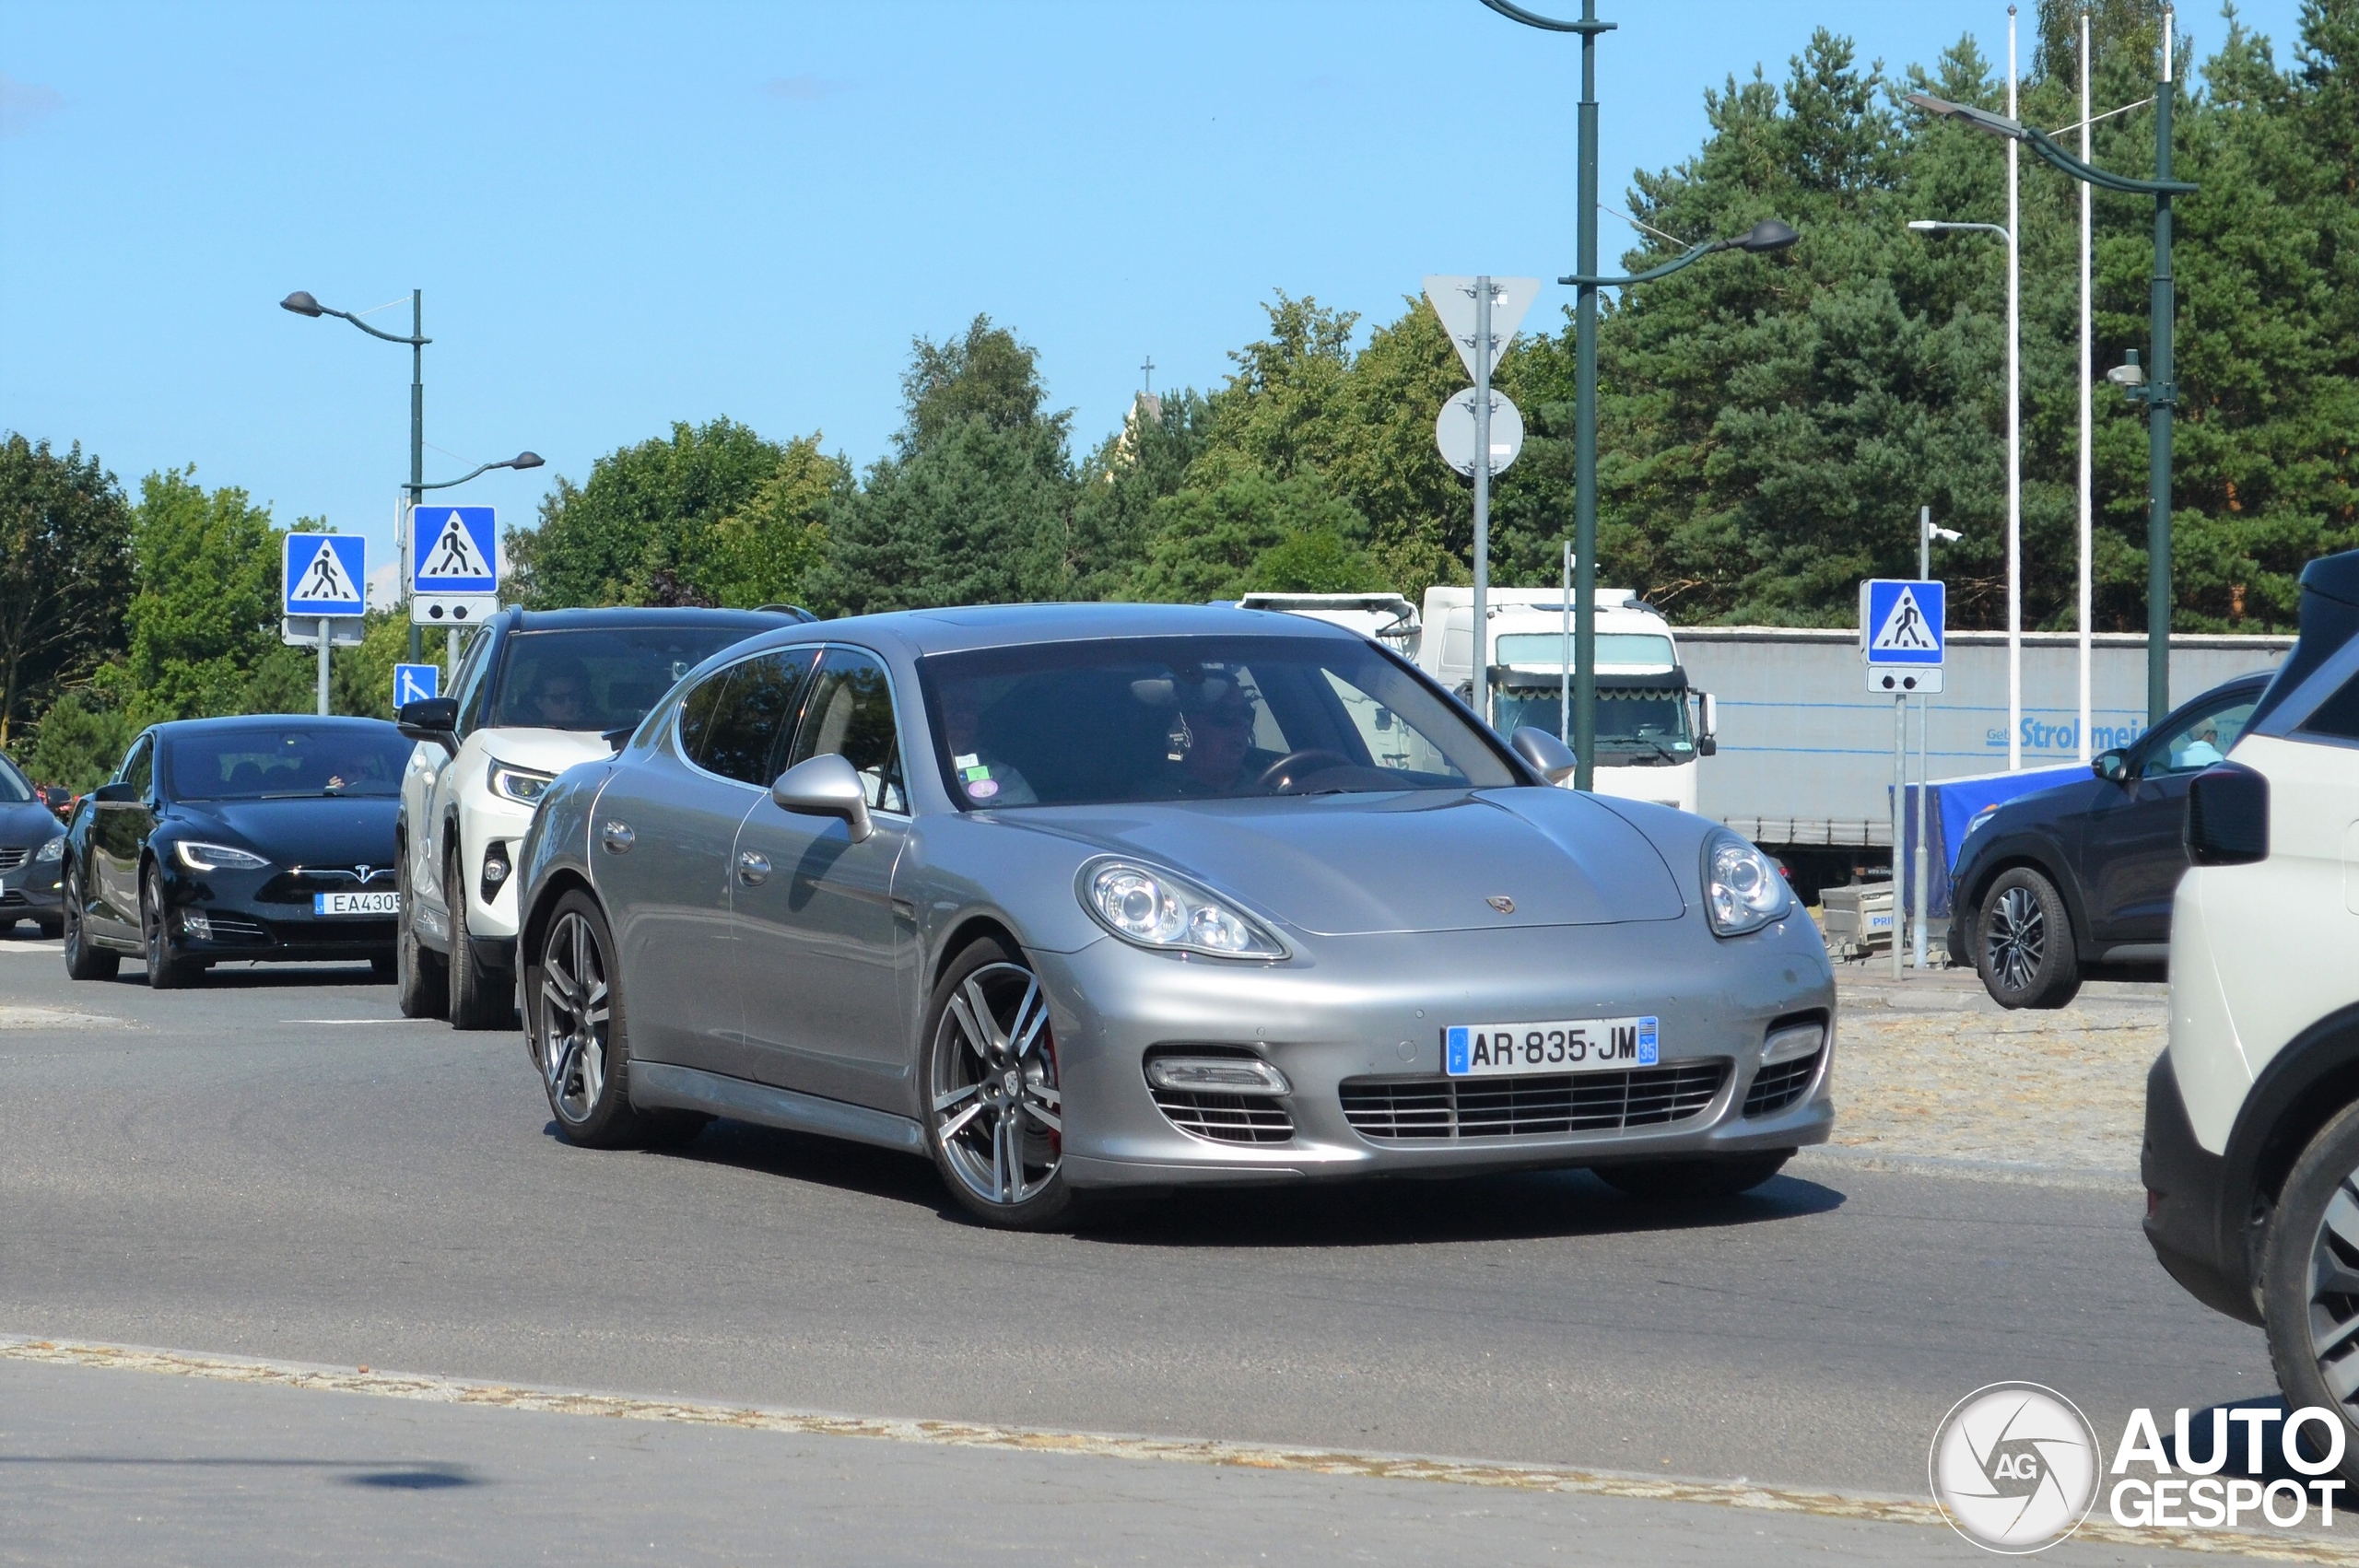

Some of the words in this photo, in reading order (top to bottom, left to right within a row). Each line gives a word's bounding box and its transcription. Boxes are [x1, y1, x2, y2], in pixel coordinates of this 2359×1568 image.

[2020, 717, 2148, 749] Stromei
[1471, 1025, 1637, 1067] AR-835-JM
[1640, 1043, 1655, 1059] 35
[1455, 1055, 1462, 1066] F
